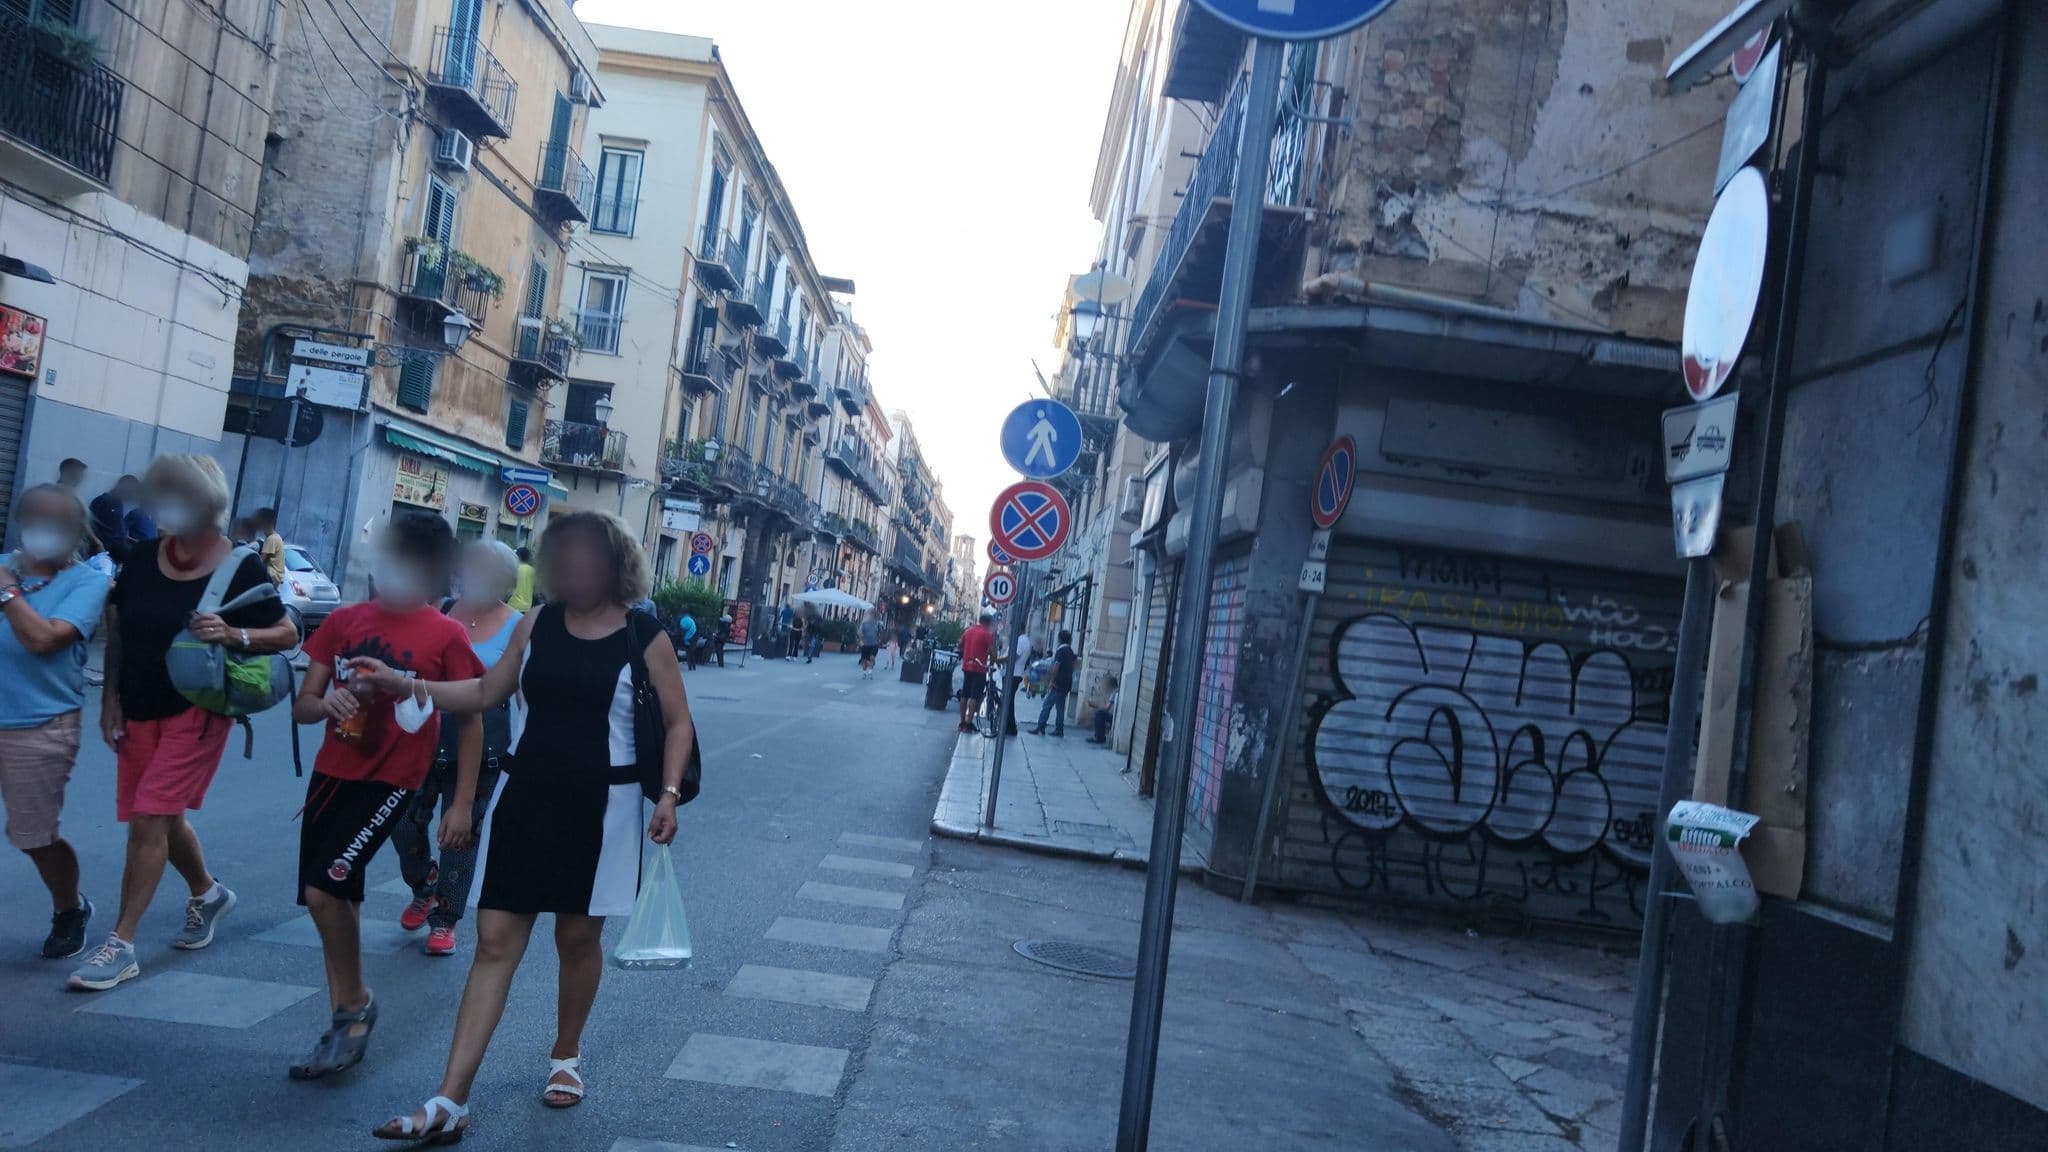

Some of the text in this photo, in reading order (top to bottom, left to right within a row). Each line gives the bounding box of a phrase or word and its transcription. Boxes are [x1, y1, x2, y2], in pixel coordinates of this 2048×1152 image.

[309, 347, 362, 361] delle pergole
[993, 580, 1008, 596] 10
